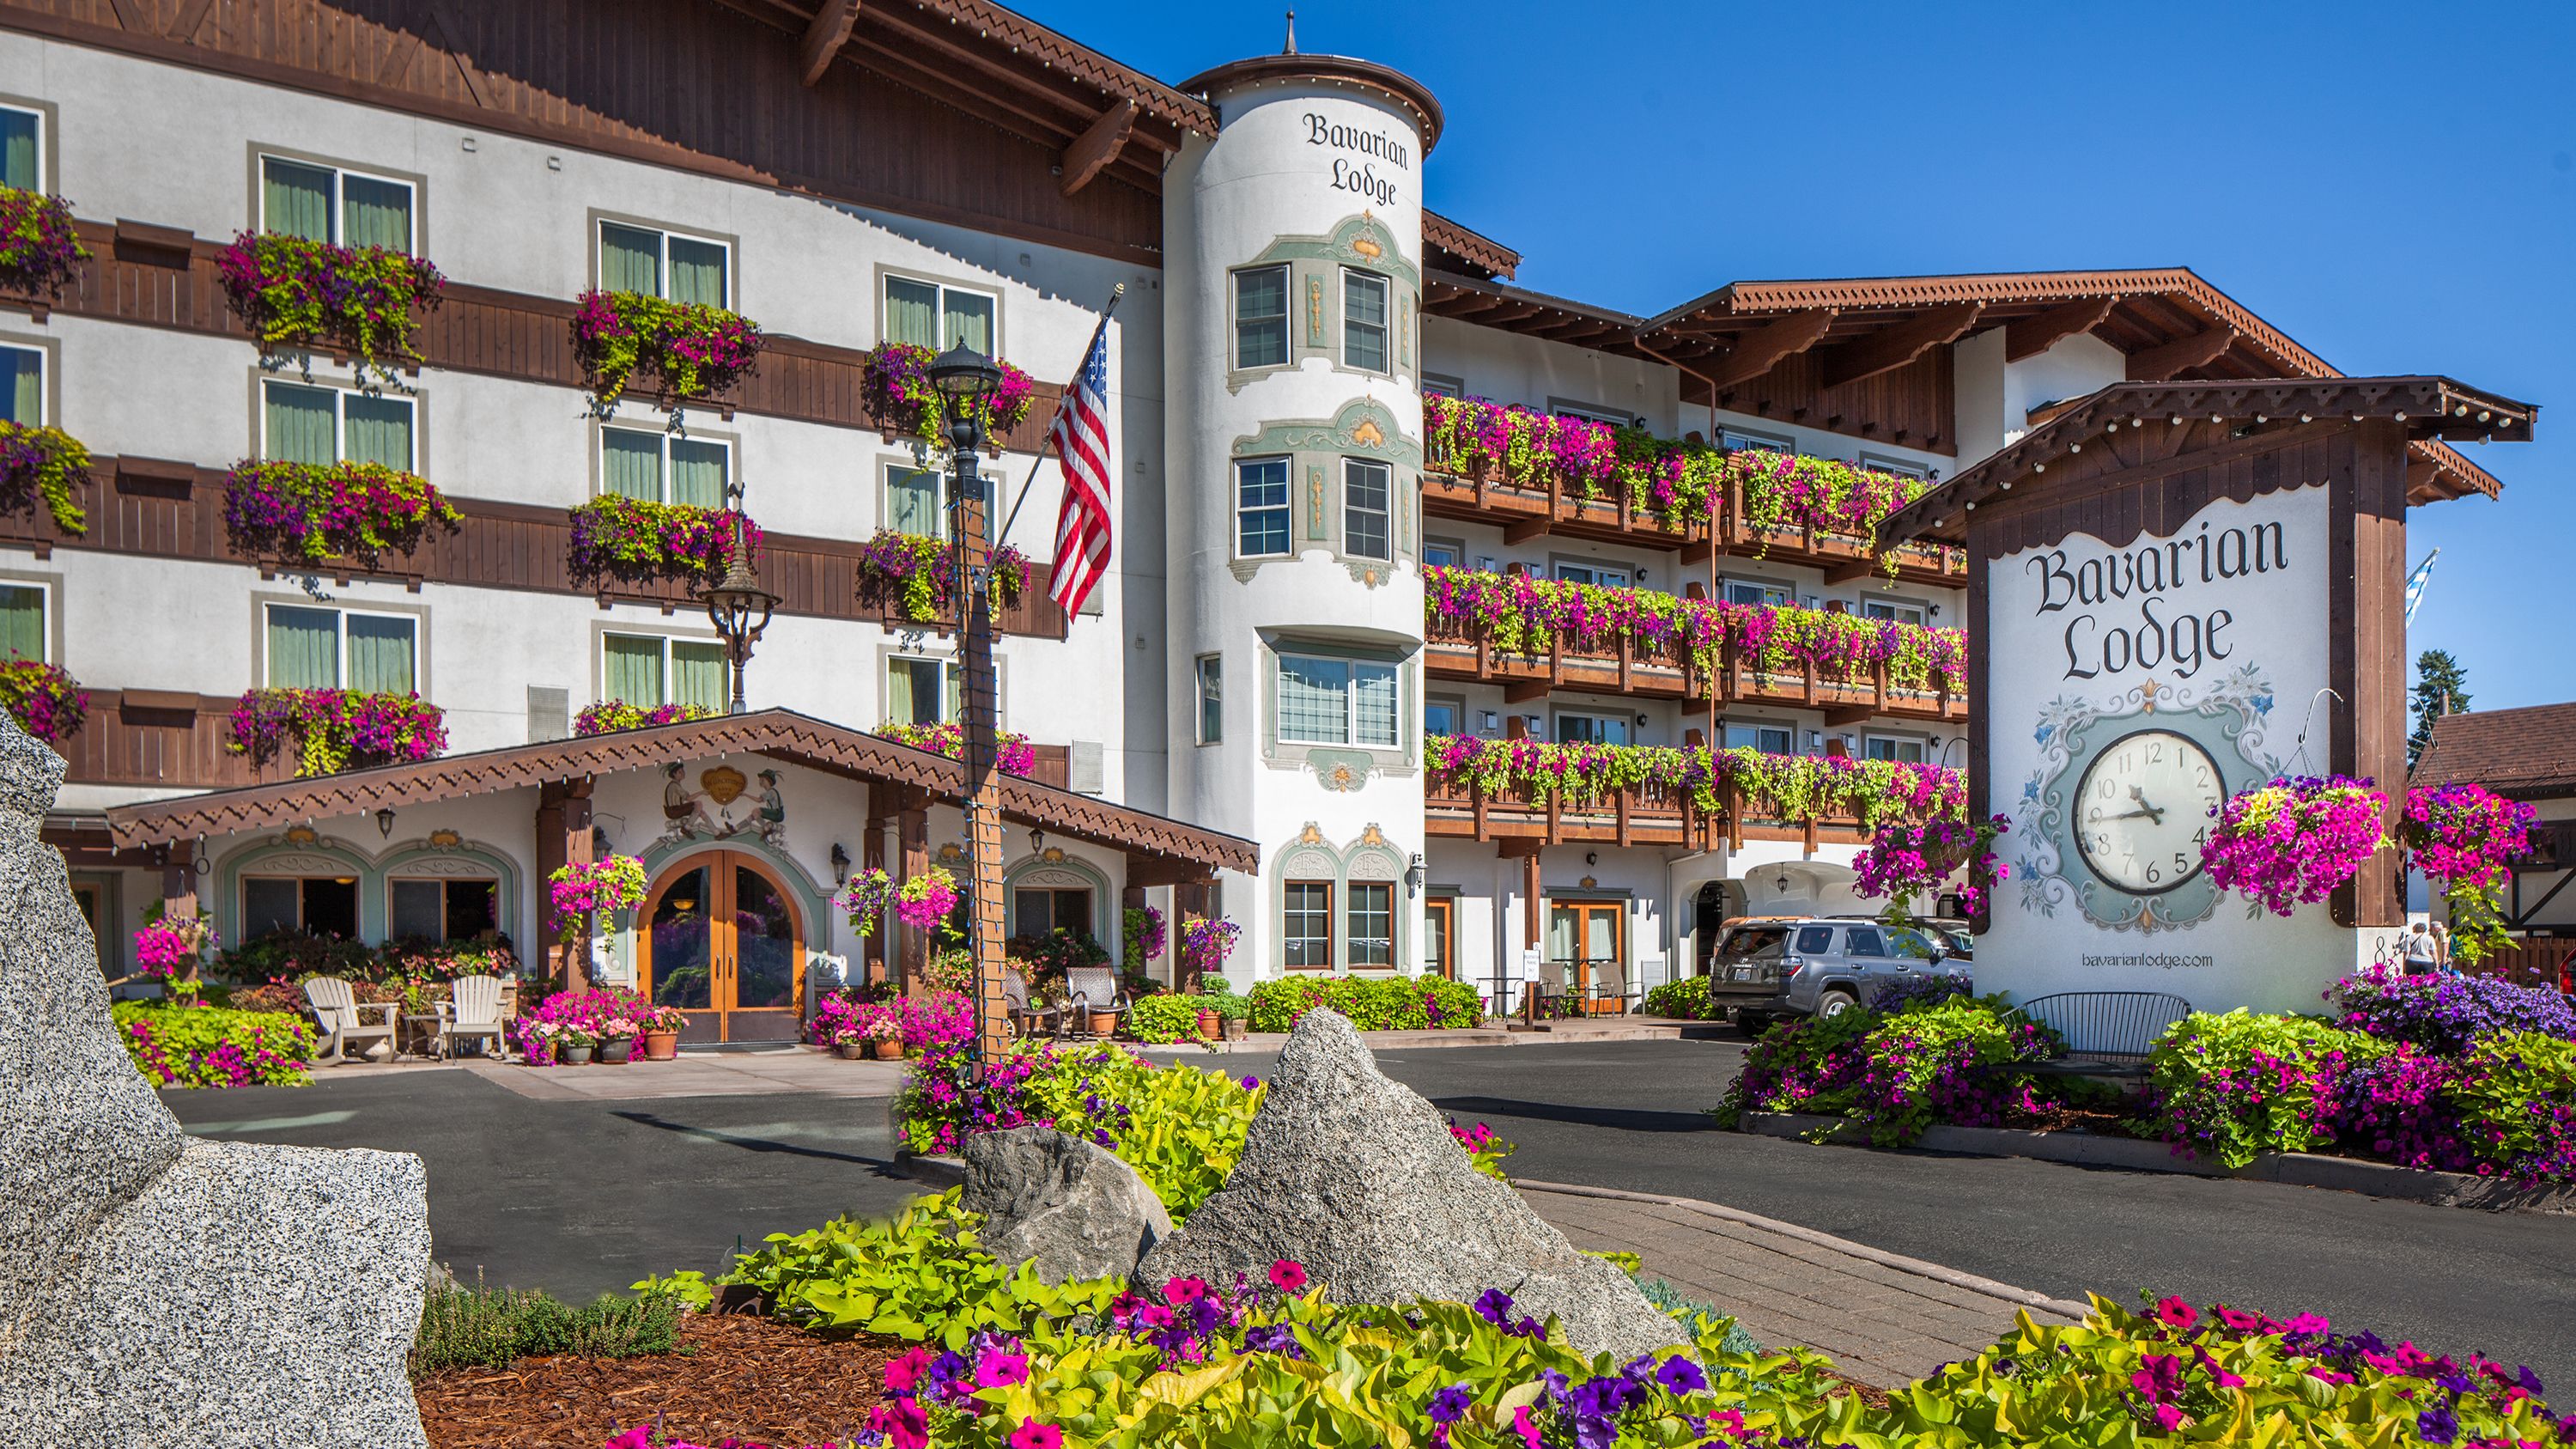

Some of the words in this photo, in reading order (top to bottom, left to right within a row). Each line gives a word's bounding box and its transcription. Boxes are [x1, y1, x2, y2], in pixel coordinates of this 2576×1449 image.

[1303, 113, 1407, 171] Bavarian
[1330, 158, 1396, 206] Lodge
[2026, 521, 2288, 617] Bavarian
[2063, 597, 2233, 681] Lodge
[2118, 752, 2132, 774] 11
[2145, 741, 2162, 765] 12
[2178, 746, 2184, 769] 1
[2196, 765, 2209, 788] 2
[2097, 778, 2116, 800] 10
[2089, 807, 2103, 827] 9
[2098, 833, 2111, 855] 8
[2191, 825, 2206, 849] 4
[2123, 853, 2135, 876] 7
[2147, 861, 2160, 884] 6
[2174, 853, 2188, 874] 5
[2082, 952, 2213, 970] bavarianlodge.com
